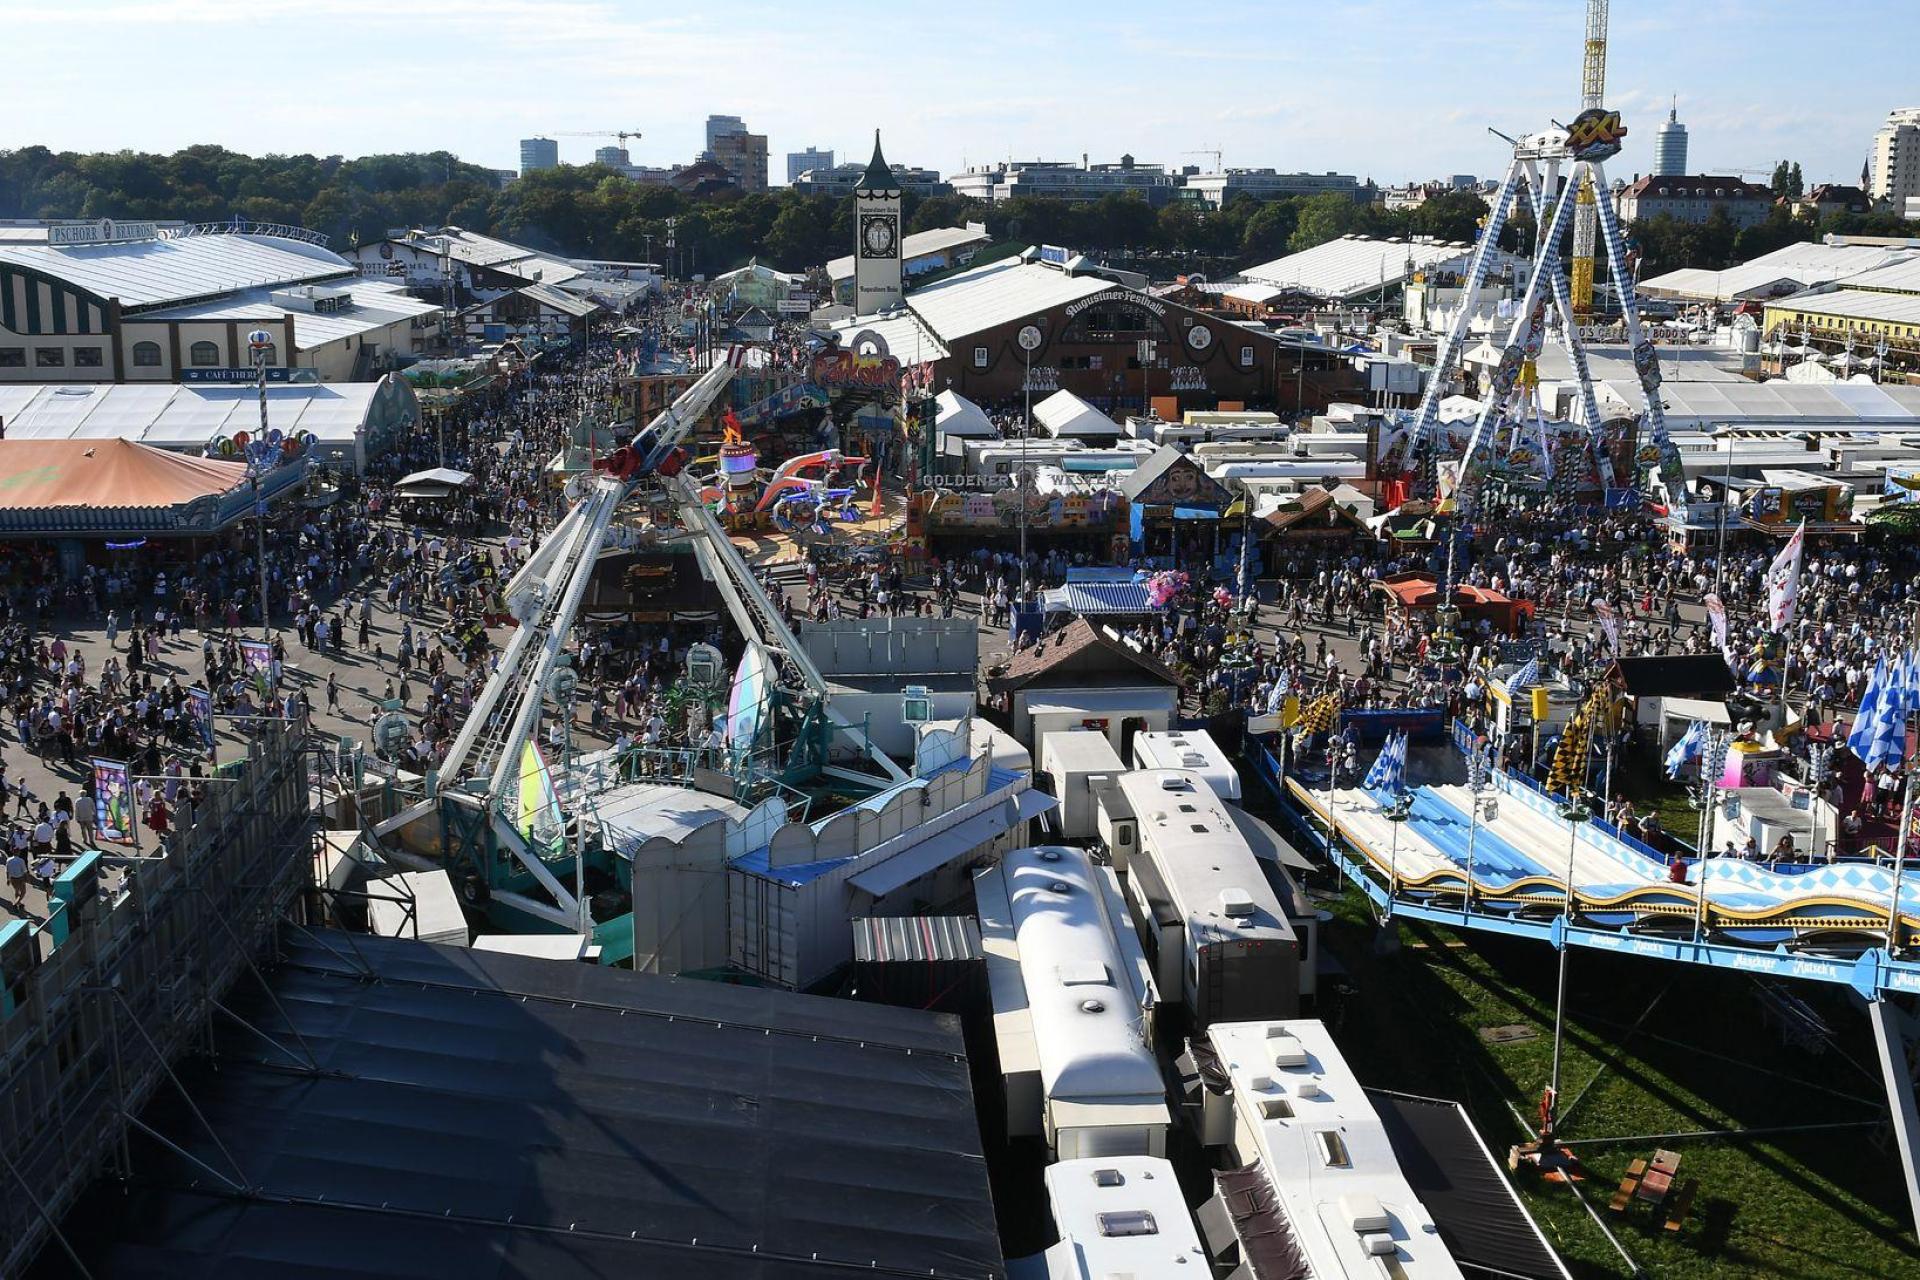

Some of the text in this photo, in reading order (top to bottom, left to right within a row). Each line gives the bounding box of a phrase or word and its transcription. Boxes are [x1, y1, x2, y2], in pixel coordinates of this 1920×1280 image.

[1567, 113, 1627, 147] XXL
[55, 227, 98, 242] PSCHORR
[229, 371, 259, 379] THERE
[923, 474, 1010, 487] GOLDENER
